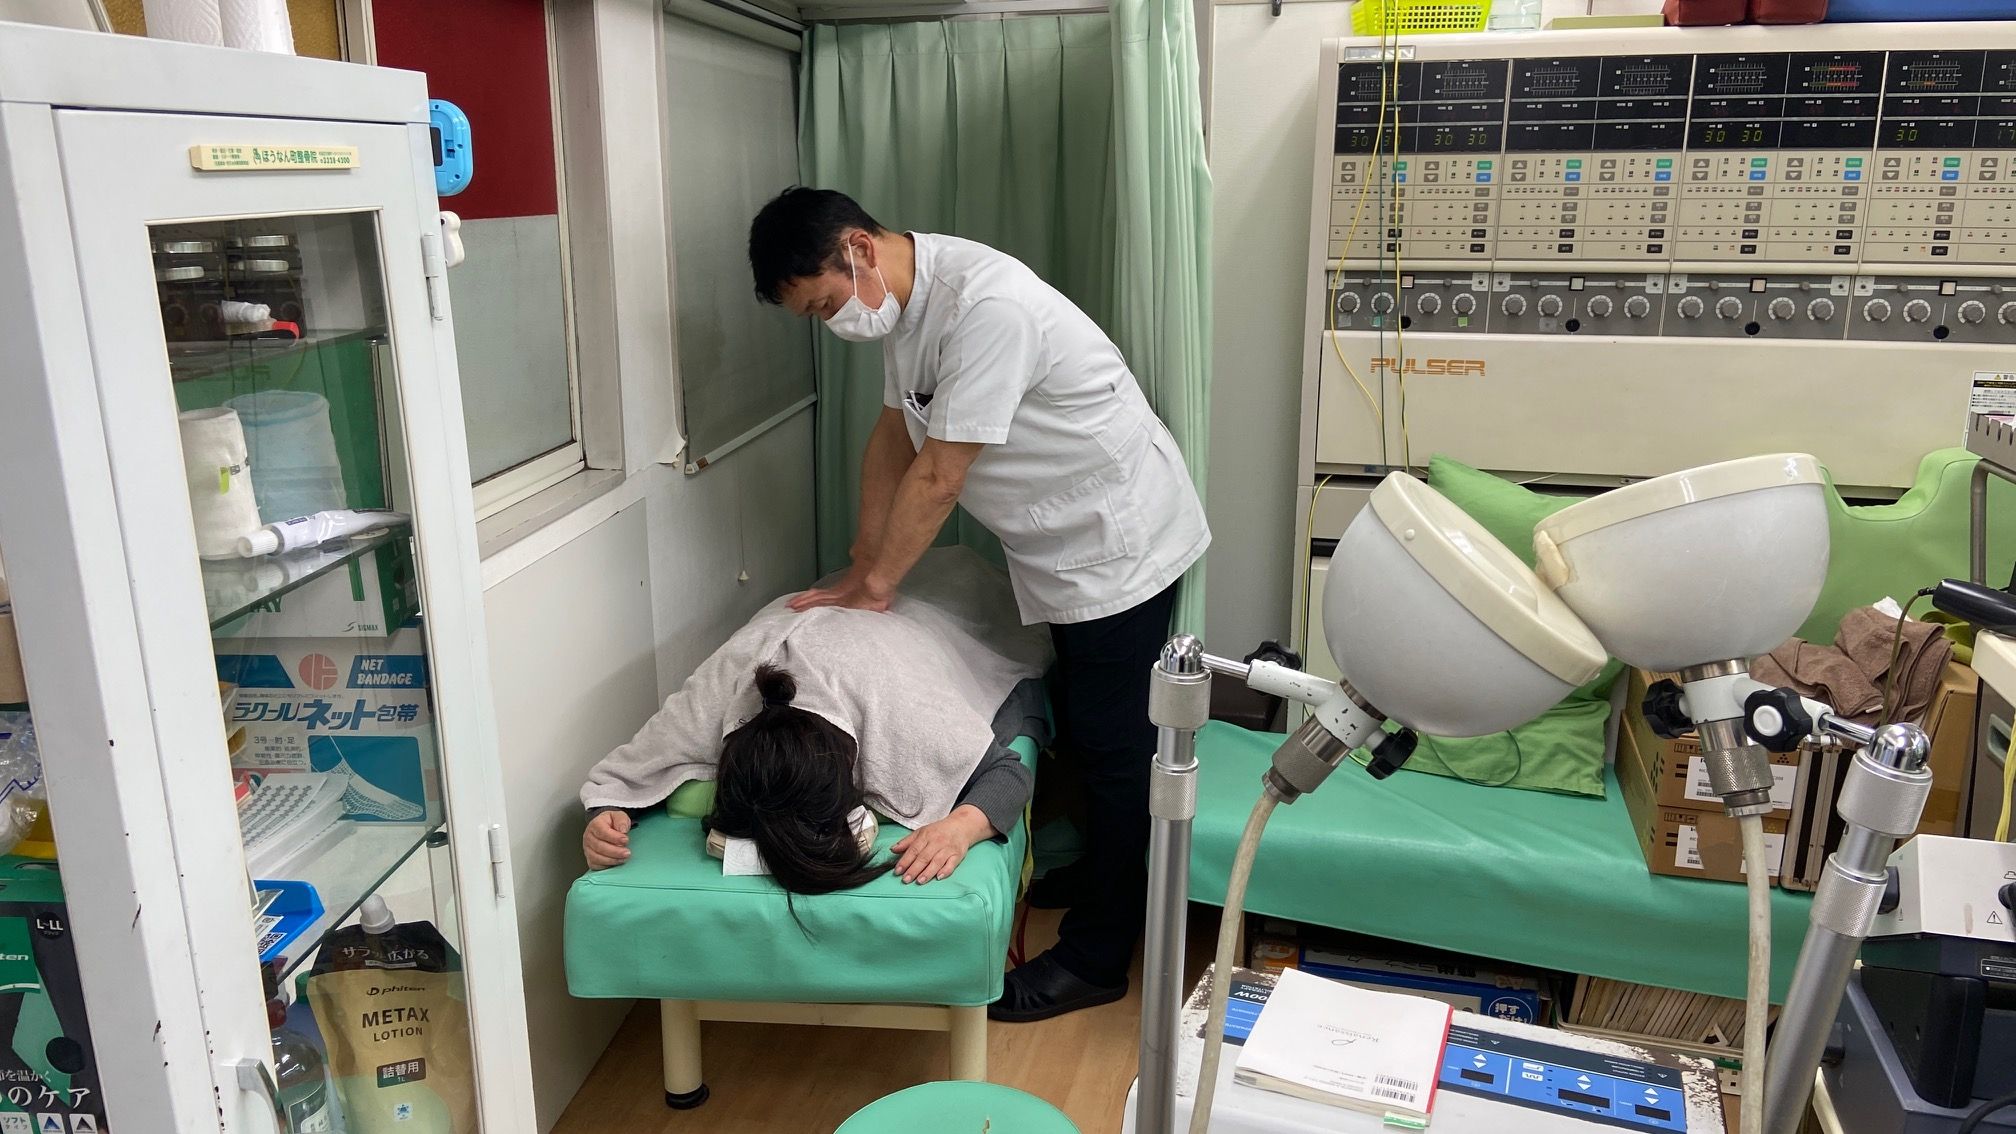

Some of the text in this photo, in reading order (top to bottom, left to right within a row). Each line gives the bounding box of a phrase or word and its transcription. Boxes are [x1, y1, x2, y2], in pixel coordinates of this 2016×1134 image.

[1351, 135, 1370, 147] 30
[1434, 134, 1487, 146] 30 30
[1705, 130, 1762, 142] 30 30
[1896, 129, 1918, 141] 30
[262, 150, 318, 164] ほうなん町整骨院
[1370, 358, 1486, 377] PULSER
[361, 659, 384, 671] NET
[357, 673, 412, 686] BANDAGE
[1494, 1002, 1521, 1014] 押す
[362, 1007, 430, 1029] METAX
[373, 1027, 423, 1042] LOTION
[382, 1061, 419, 1079] 詰替用
